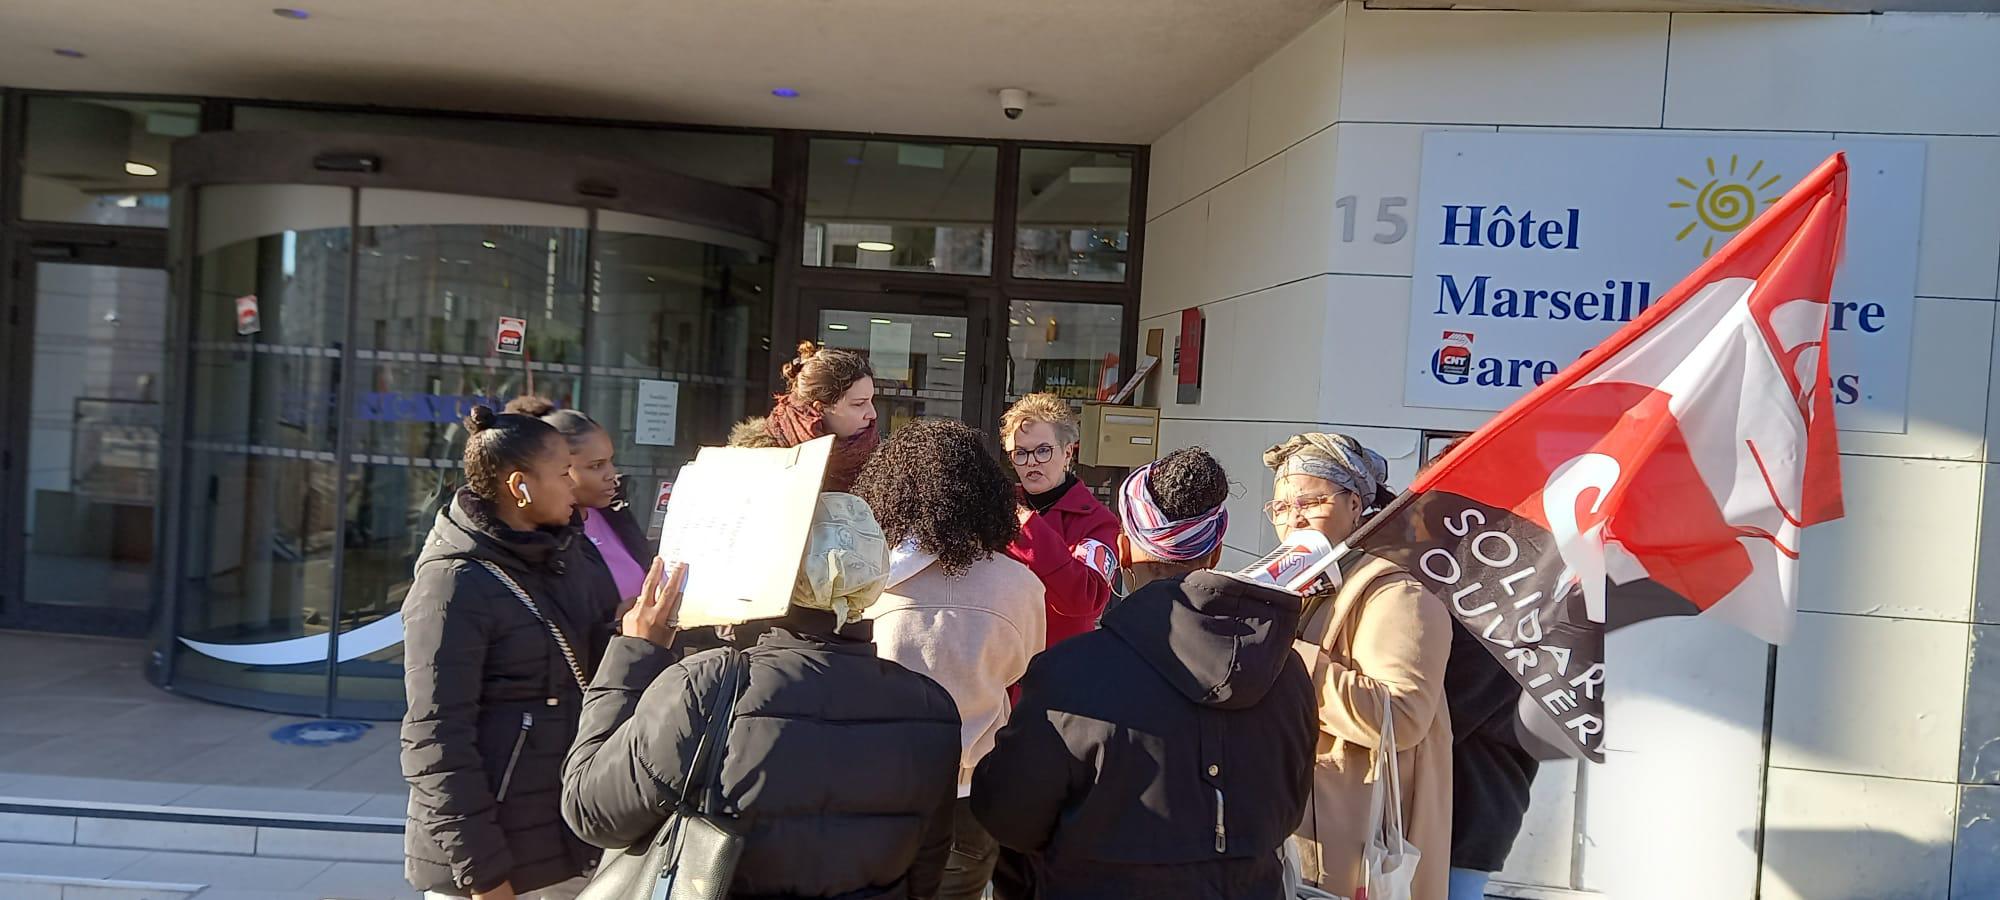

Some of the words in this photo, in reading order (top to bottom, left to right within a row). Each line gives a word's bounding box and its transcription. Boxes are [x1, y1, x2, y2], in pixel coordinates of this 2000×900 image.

[1336, 195, 1408, 244] 15
[1439, 205, 1579, 249] Hôtel
[1433, 274, 1662, 322] Marseill
[1443, 355, 1467, 366] CNT
[1303, 578, 1324, 598] NT
[1443, 508, 1605, 702] SOLIDAR
[1419, 548, 1605, 754] OUVRIÈR
